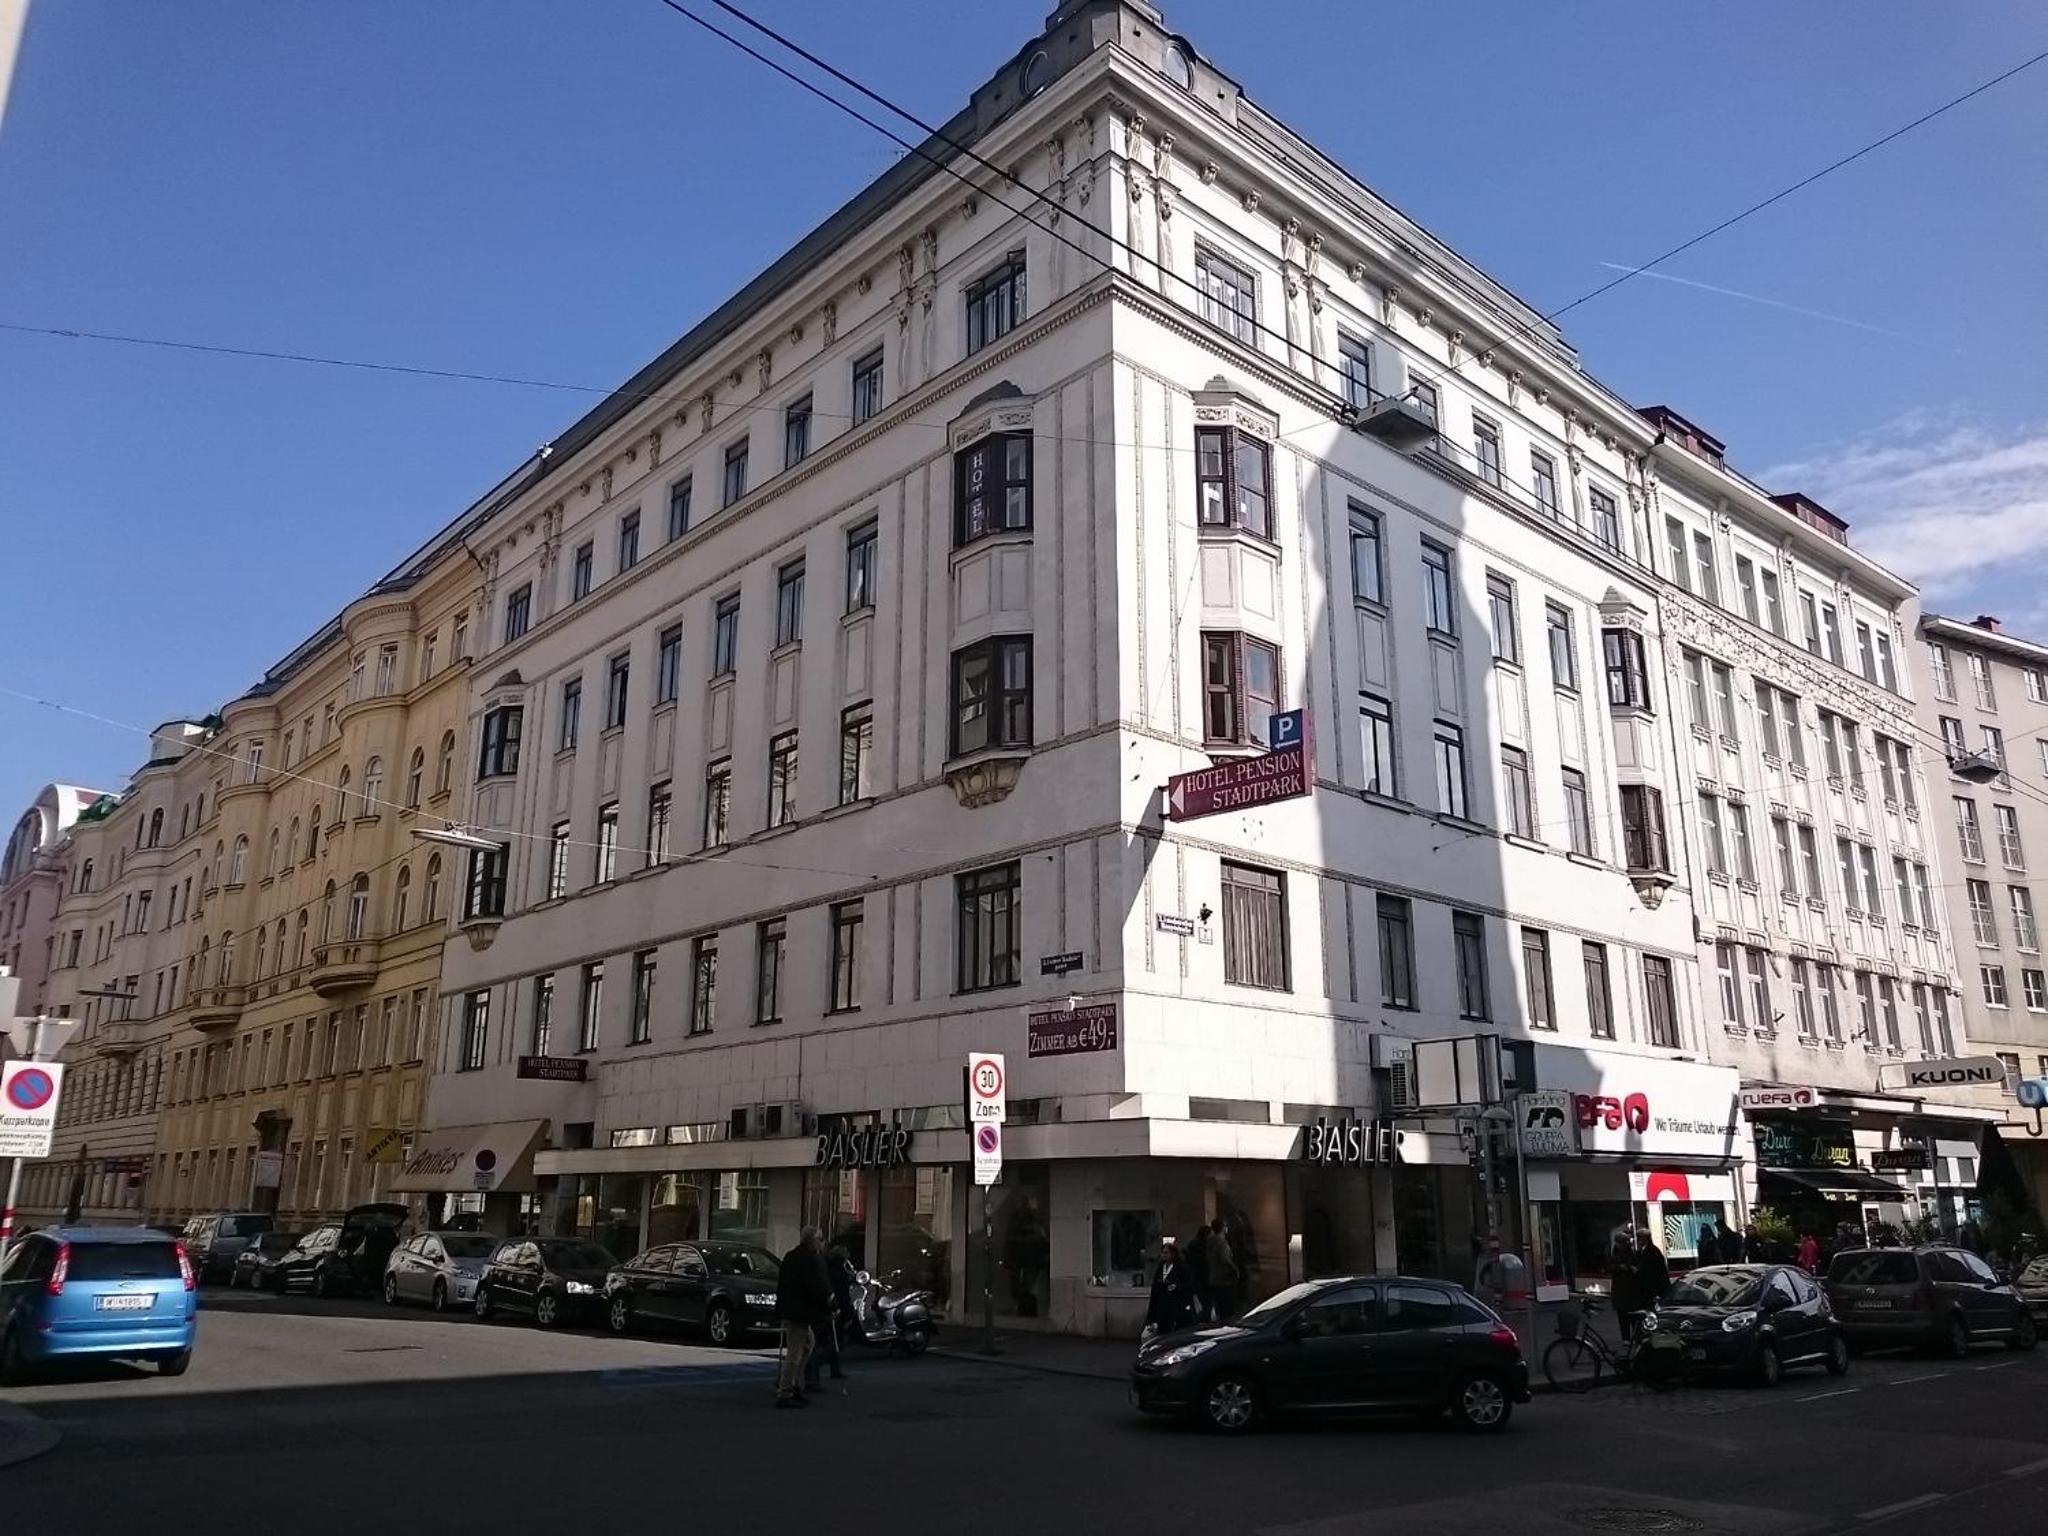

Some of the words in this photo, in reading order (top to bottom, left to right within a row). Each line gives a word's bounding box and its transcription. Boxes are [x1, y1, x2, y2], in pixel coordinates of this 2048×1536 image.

[972, 453, 982, 533] HOTEL
[1278, 716, 1293, 740] P
[1186, 767, 1234, 793] HOTEL
[1236, 751, 1301, 782] PENSION
[1212, 774, 1302, 809] STADTPARK
[1030, 1032, 1065, 1052] ZIMMER
[1066, 1034, 1078, 1048] AB
[980, 1070, 995, 1088] 30
[1911, 1067, 1992, 1085] KUONI
[1742, 1092, 1793, 1105] ruefa
[816, 1130, 908, 1166] BASLER
[1308, 1124, 1406, 1162] BASLER
